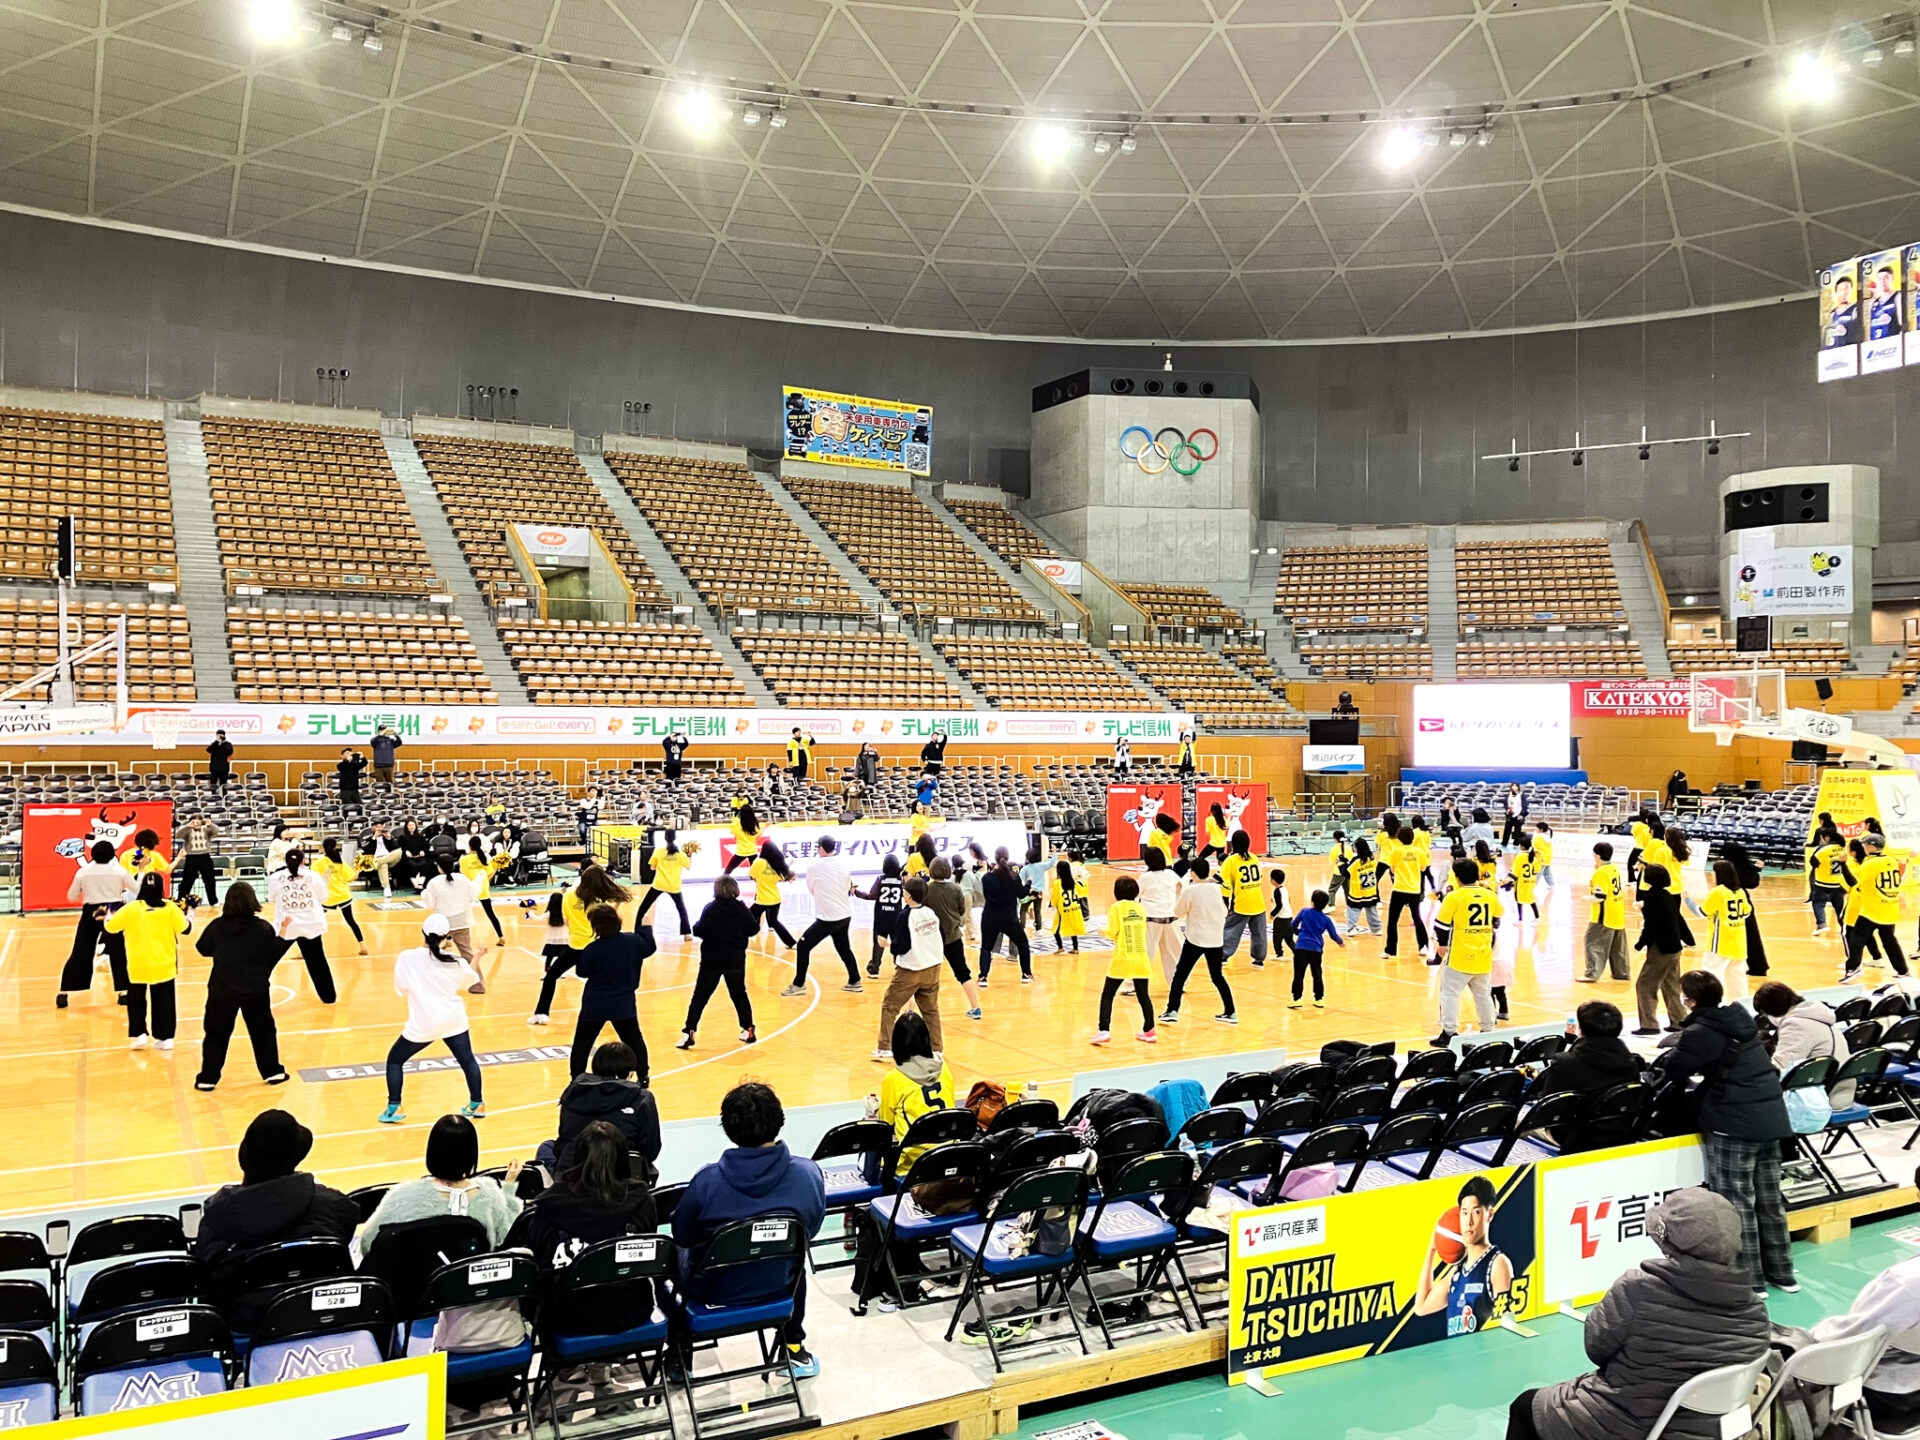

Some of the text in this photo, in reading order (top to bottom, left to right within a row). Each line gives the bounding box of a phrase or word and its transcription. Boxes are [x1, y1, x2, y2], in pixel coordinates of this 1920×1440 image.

[1863, 260, 1873, 276] 3
[1777, 585, 1845, 598] 前田製作所
[307, 714, 420, 736] テレビ信州
[557, 721, 592, 732] every.
[632, 716, 727, 736] テレビ信州
[901, 718, 979, 737] テレビ信州
[1103, 720, 1171, 737] テレビ信州
[1238, 863, 1260, 883] 30
[879, 886, 901, 904] 23
[1467, 903, 1489, 926] 21
[920, 1081, 947, 1110] 5
[1263, 1217, 1319, 1242] 高沢産業
[1248, 1257, 1332, 1307] DAIKI
[1492, 1276, 1528, 1318] #5
[1246, 1285, 1395, 1347] TSUCHIYA
